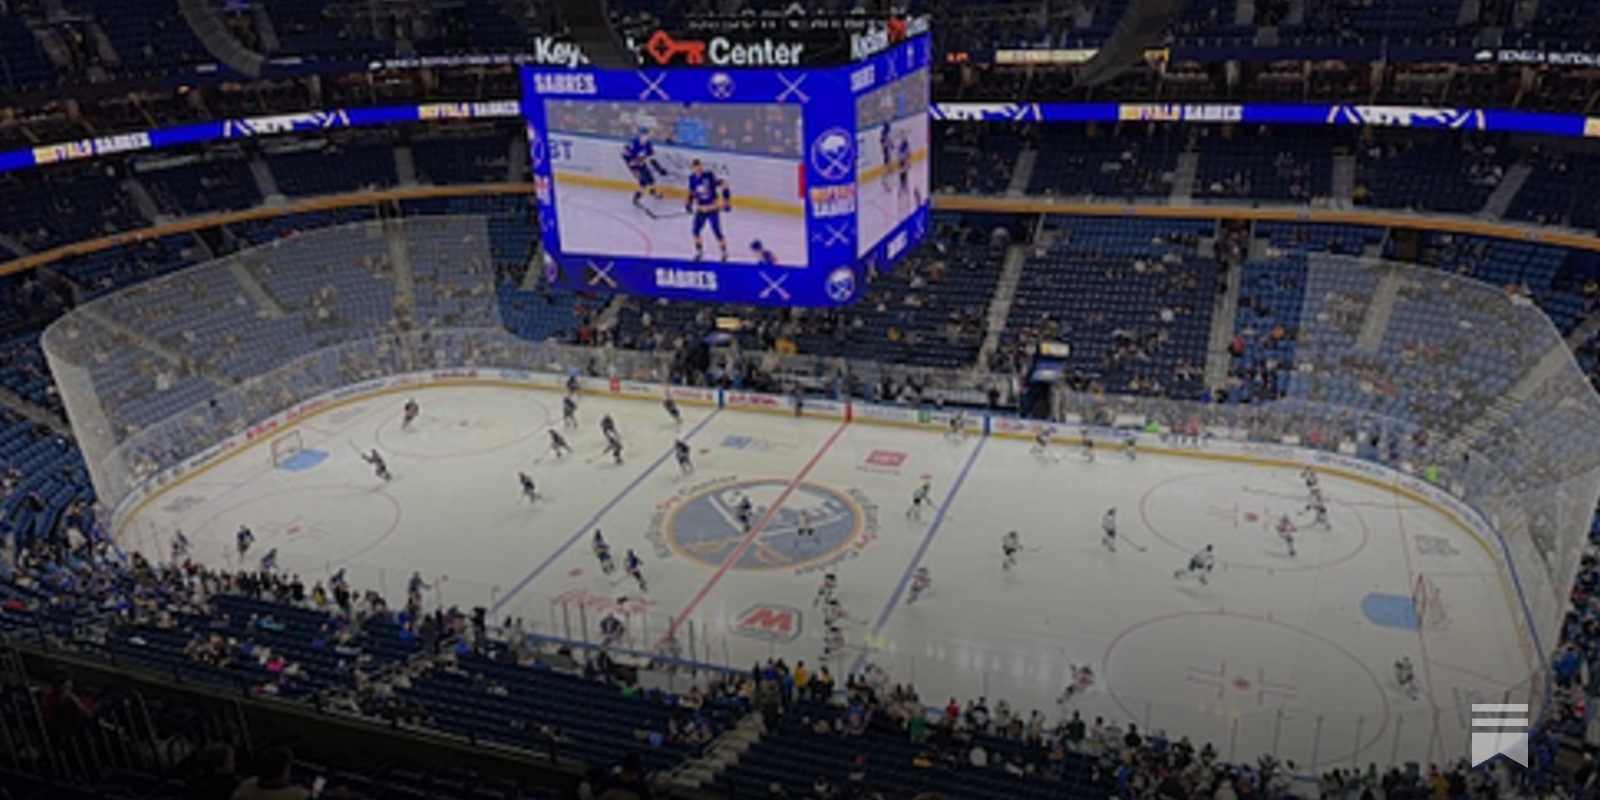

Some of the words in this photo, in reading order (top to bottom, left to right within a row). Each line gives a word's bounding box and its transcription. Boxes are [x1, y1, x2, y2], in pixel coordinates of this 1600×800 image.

[708, 37, 803, 64] Center
[533, 73, 597, 95] SABRES
[655, 267, 717, 292] SABRES
